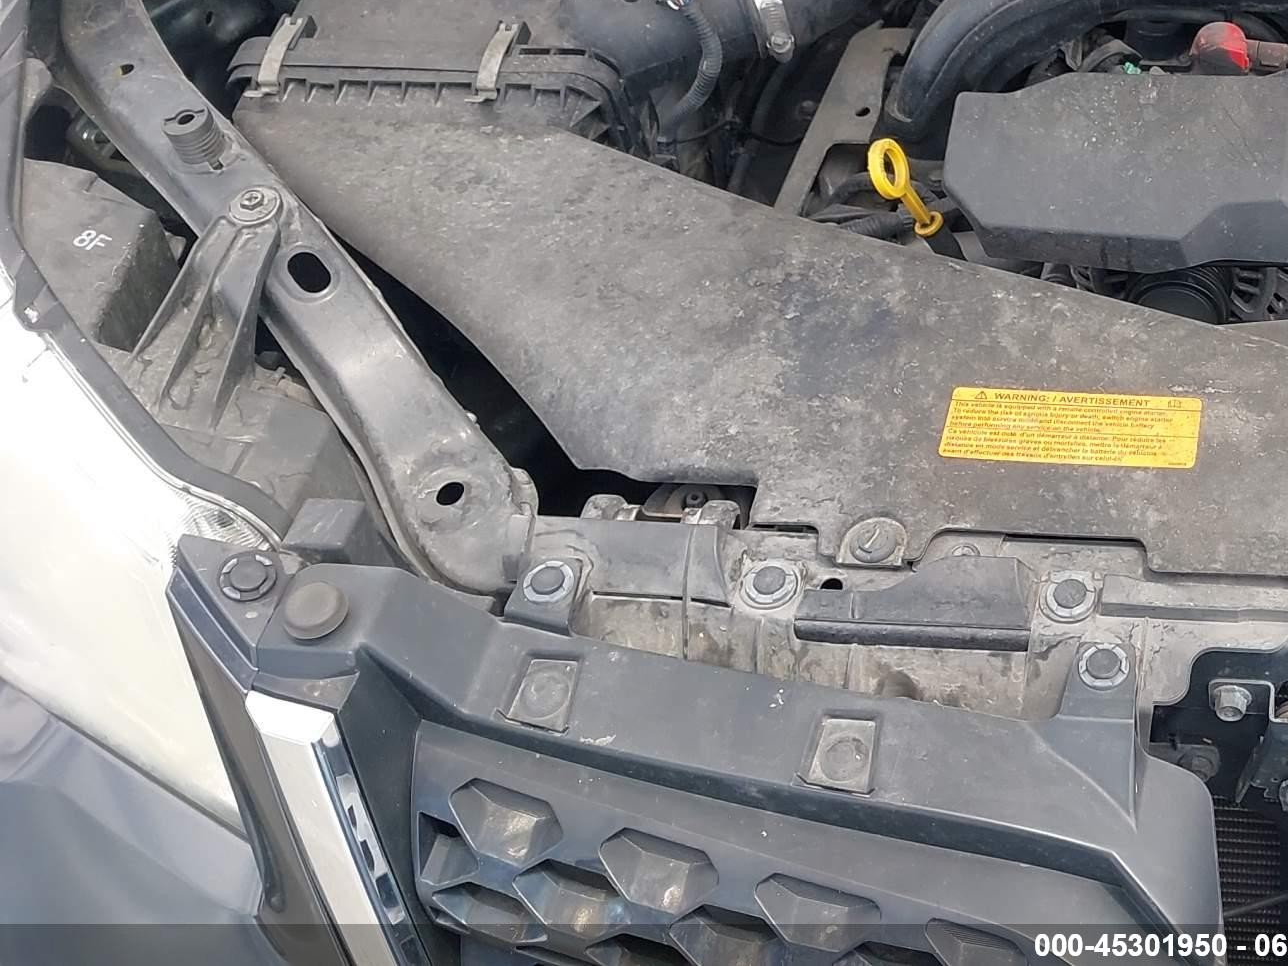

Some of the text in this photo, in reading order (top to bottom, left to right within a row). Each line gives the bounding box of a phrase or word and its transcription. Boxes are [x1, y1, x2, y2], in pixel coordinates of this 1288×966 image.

[73, 230, 112, 250] 8F
[993, 392, 1049, 402] WARNING:
[1059, 395, 1150, 406] AVERTISSEMENT
